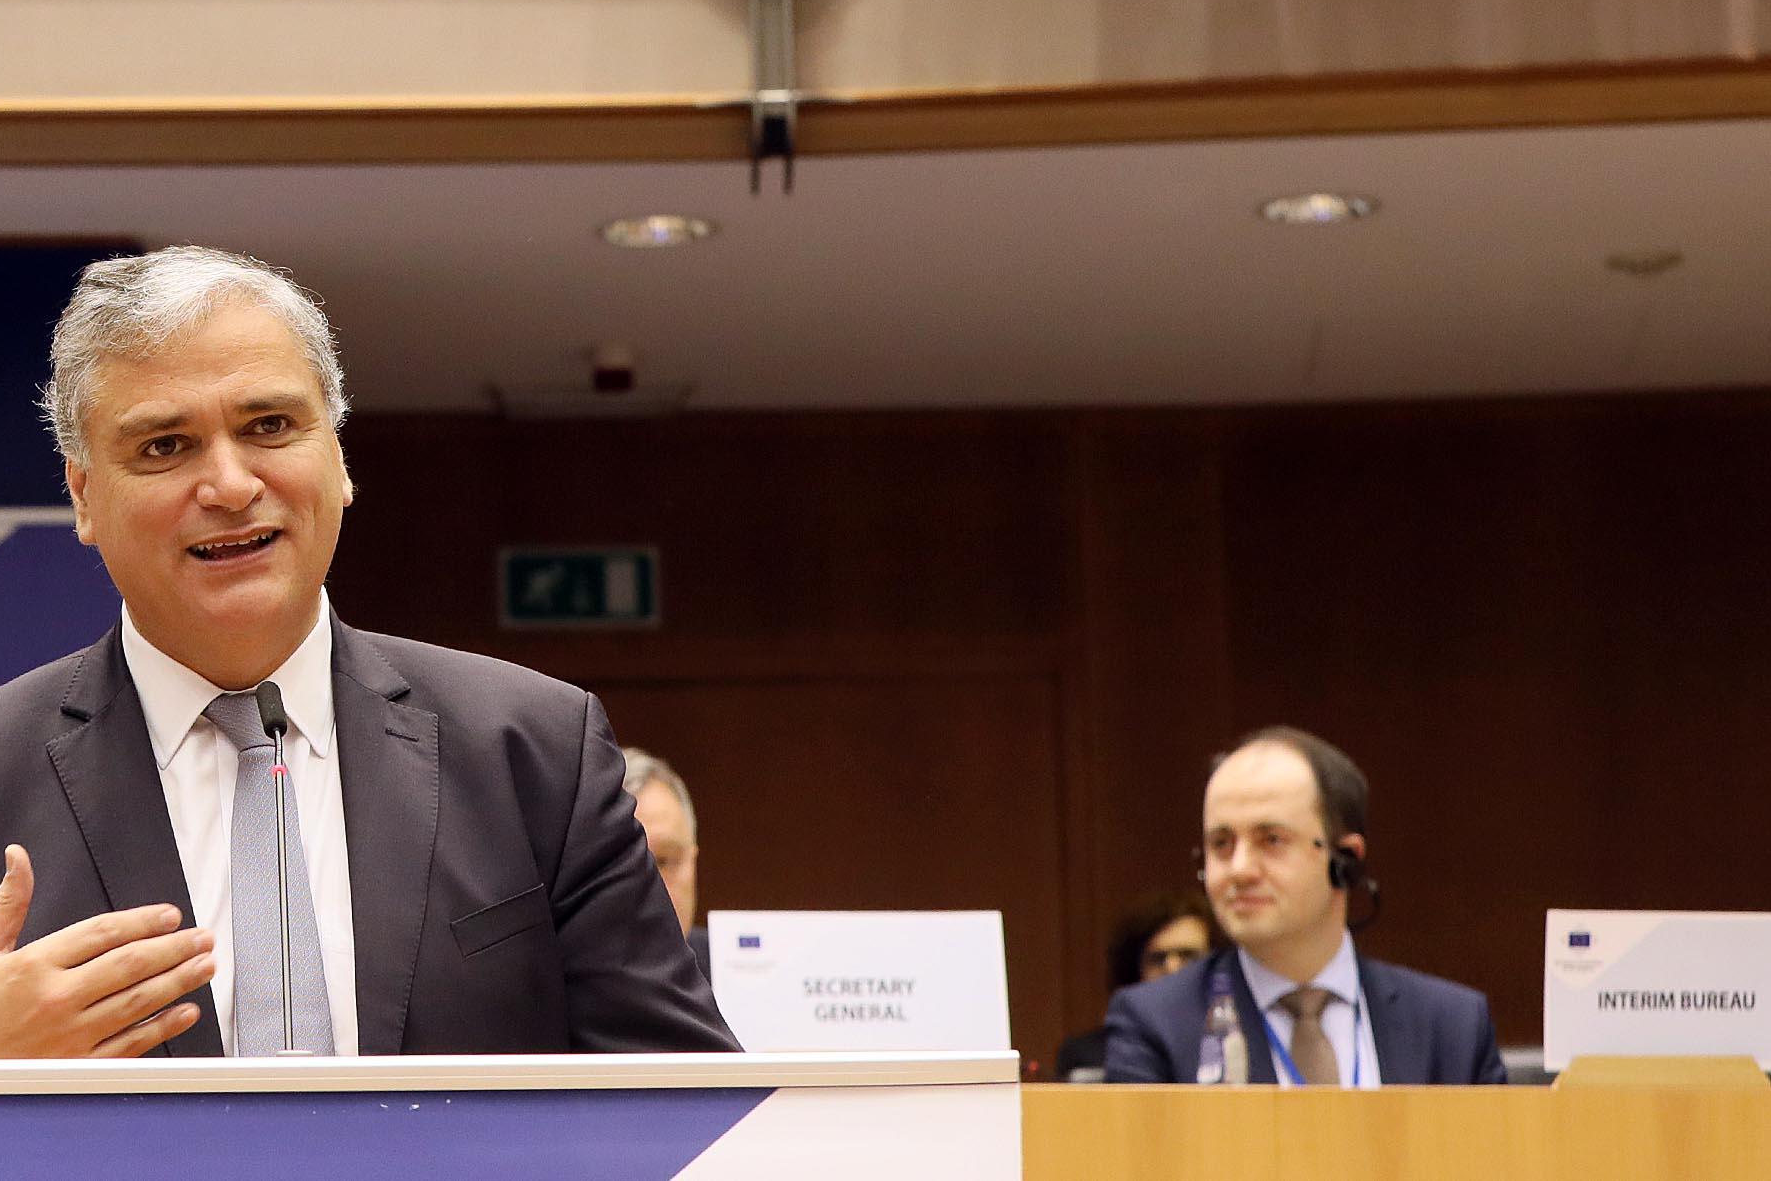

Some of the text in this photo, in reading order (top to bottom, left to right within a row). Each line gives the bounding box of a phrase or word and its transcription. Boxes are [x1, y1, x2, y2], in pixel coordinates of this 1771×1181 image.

[803, 976, 916, 998] SECRETARY
[1597, 990, 1757, 1011] INTERIM BUREAU
[814, 1001, 909, 1023] GENERAL
